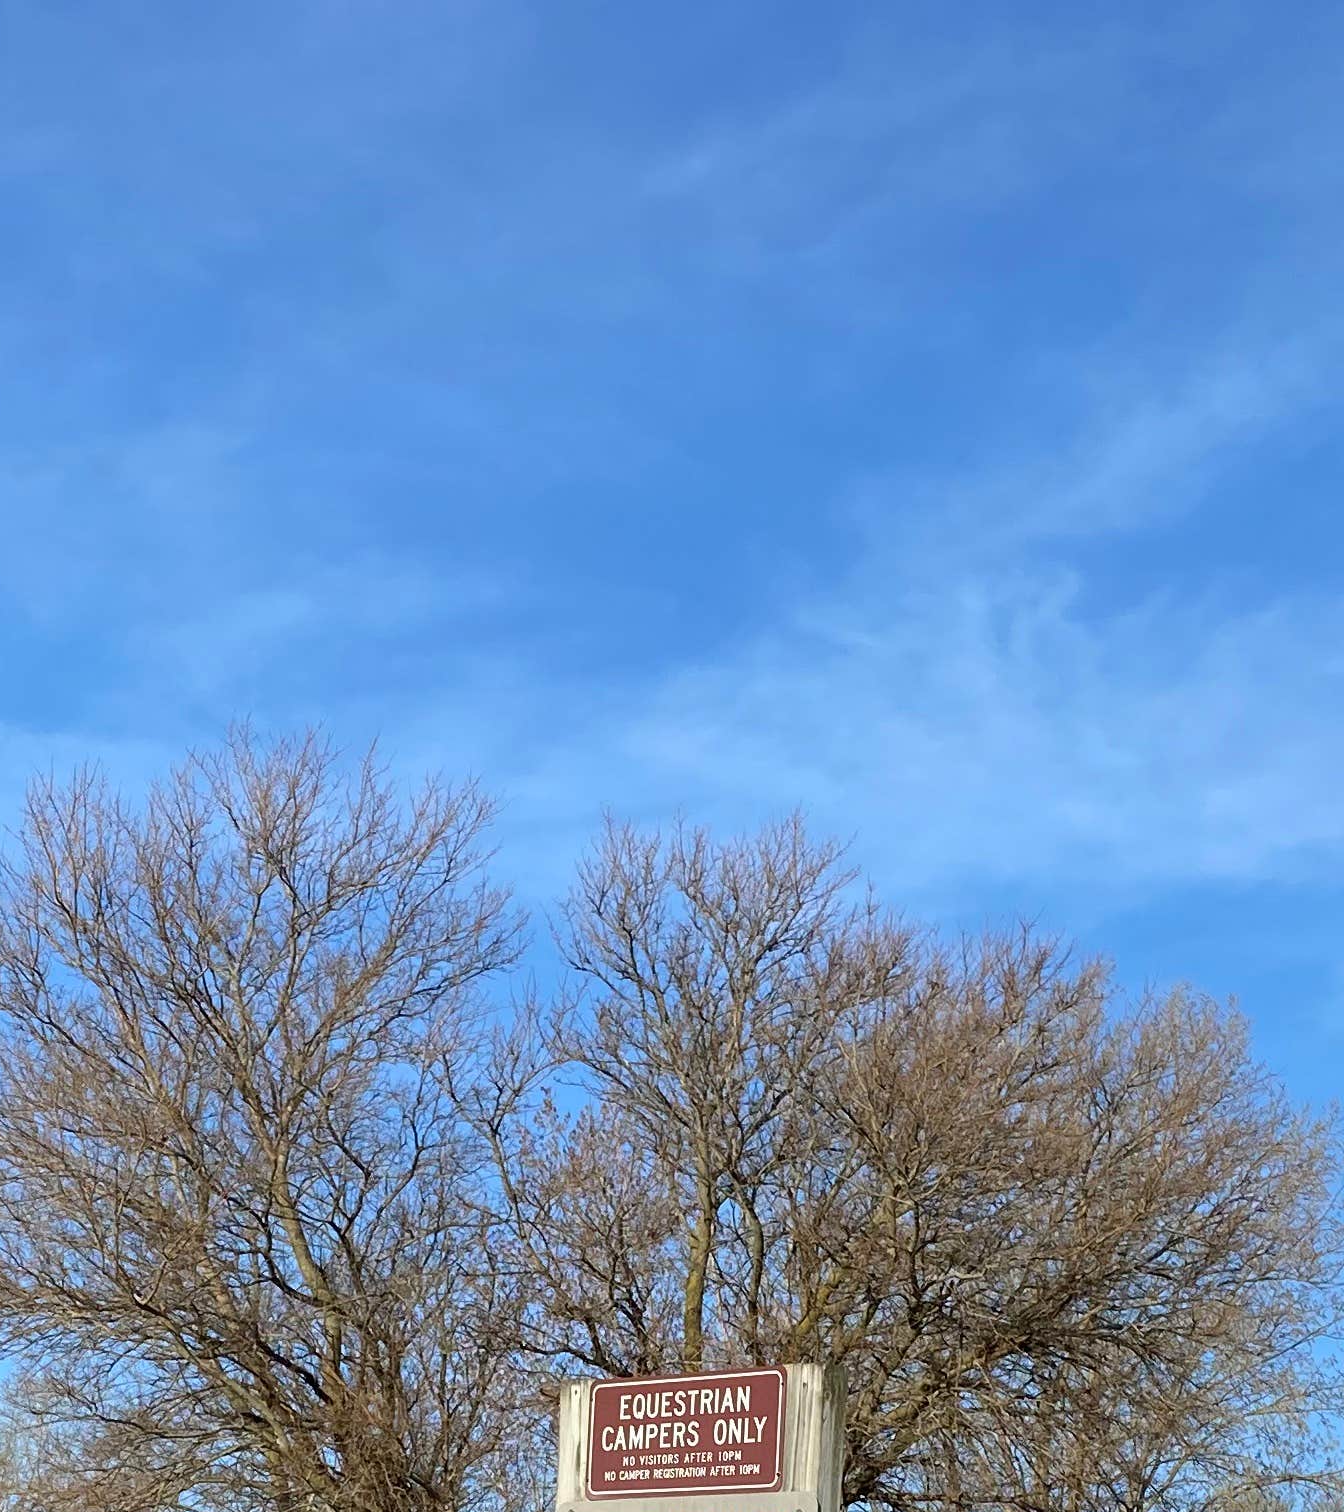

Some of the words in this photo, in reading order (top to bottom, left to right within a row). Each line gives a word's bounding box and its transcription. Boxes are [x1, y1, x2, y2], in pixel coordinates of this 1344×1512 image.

[619, 1386, 751, 1421] EQUESTRIAN
[601, 1421, 700, 1452] CAMPERS
[713, 1416, 768, 1445] ONLY
[622, 1456, 636, 1467] NO
[639, 1453, 680, 1466] VISITORS
[684, 1451, 713, 1463] AFTER
[718, 1450, 742, 1462] 10PM
[604, 1470, 616, 1482] NO
[619, 1469, 650, 1481] CAMPER
[653, 1466, 706, 1479] REGISTRATION
[709, 1464, 736, 1477] AFTER
[739, 1463, 761, 1475] 10PM
